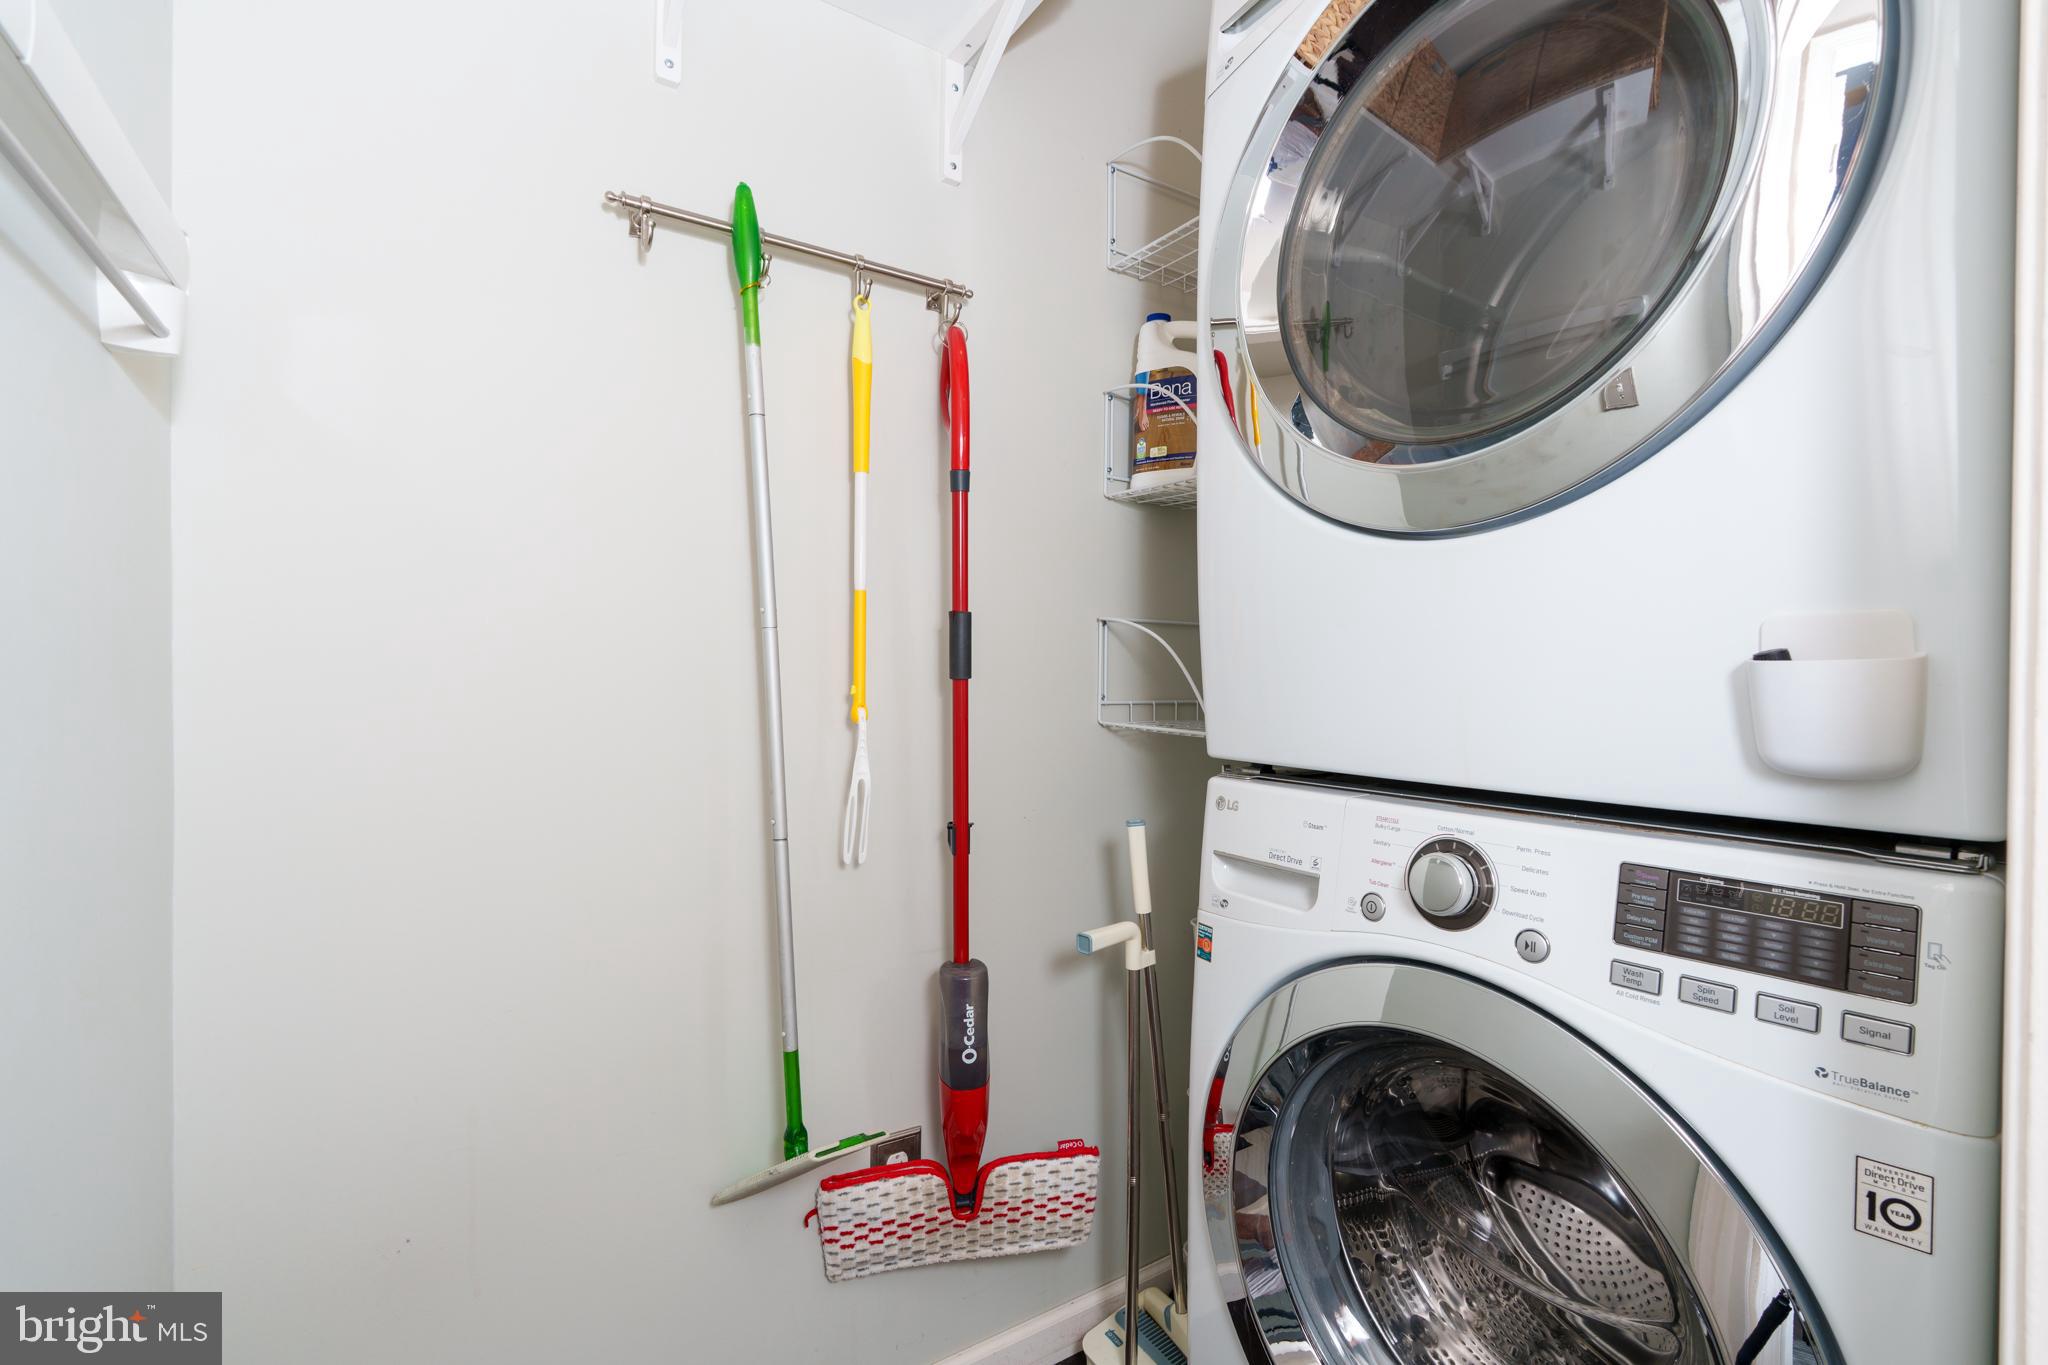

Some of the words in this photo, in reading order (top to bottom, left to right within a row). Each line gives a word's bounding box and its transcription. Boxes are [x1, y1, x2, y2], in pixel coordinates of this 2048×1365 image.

[1150, 381, 1192, 399] Bona
[1226, 800, 1239, 811] LG
[1268, 851, 1286, 863] Direct
[1287, 855, 1303, 866] Drive
[1534, 848, 1551, 857] Press
[1521, 865, 1549, 876] Delicates
[1510, 885, 1528, 895] Speed
[1530, 888, 1548, 898] Wash
[1501, 908, 1528, 920] Download
[1529, 913, 1545, 923] Cycle
[1642, 917, 1656, 925] Wash
[1622, 967, 1644, 979] Wash
[1622, 975, 1643, 987] Temp
[1697, 985, 1716, 996] Spin
[1625, 991, 1639, 1000] Cold
[1640, 995, 1661, 1006] Rinses
[1692, 993, 1719, 1005] Speed
[1778, 1004, 1795, 1014] Soil
[1774, 1013, 1799, 1024] Level
[1859, 1025, 1891, 1041] Signal
[1873, 1165, 1916, 1181] INVERTER
[1864, 1168, 1895, 1184] Direct
[1897, 1177, 1925, 1192] Drive
[1873, 1179, 1915, 1195] MOTOR
[1866, 1190, 1922, 1232] 10
[1890, 1209, 1912, 1221] YEAR
[1864, 1223, 1922, 1246] WARRANTY
